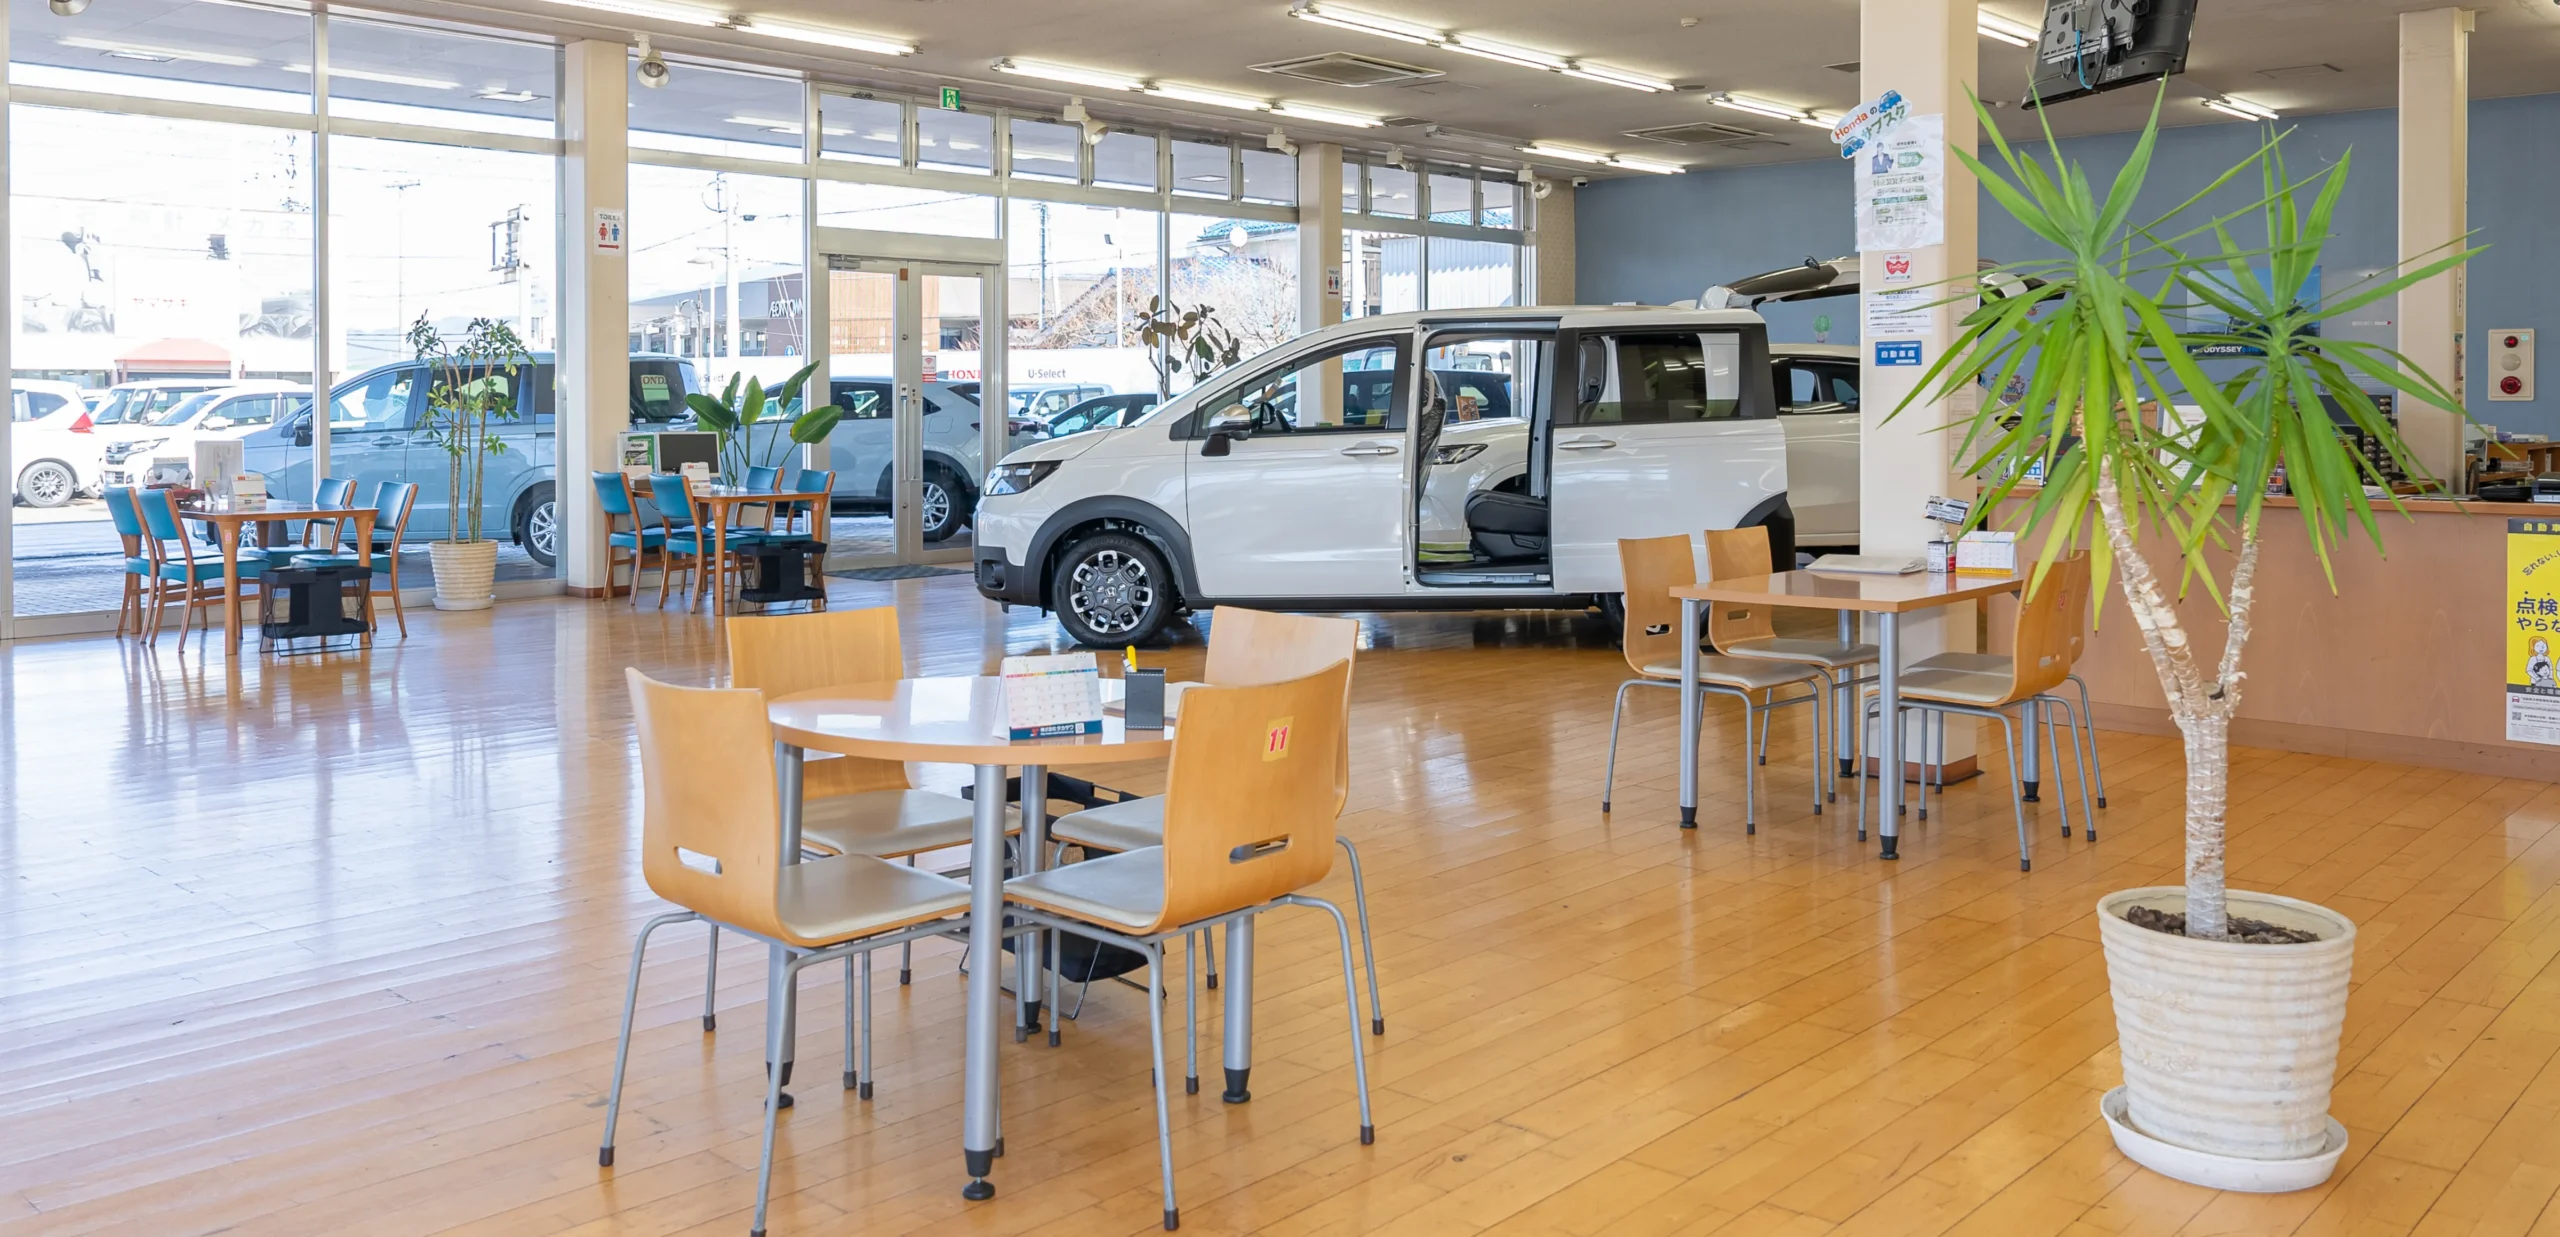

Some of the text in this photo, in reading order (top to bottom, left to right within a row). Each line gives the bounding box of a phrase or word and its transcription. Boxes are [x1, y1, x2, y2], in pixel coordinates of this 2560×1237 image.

[1835, 113, 1869, 139] Honda
[642, 375, 667, 385] OND
[1028, 368, 1066, 379] U-Select
[1269, 726, 1288, 751] 11
